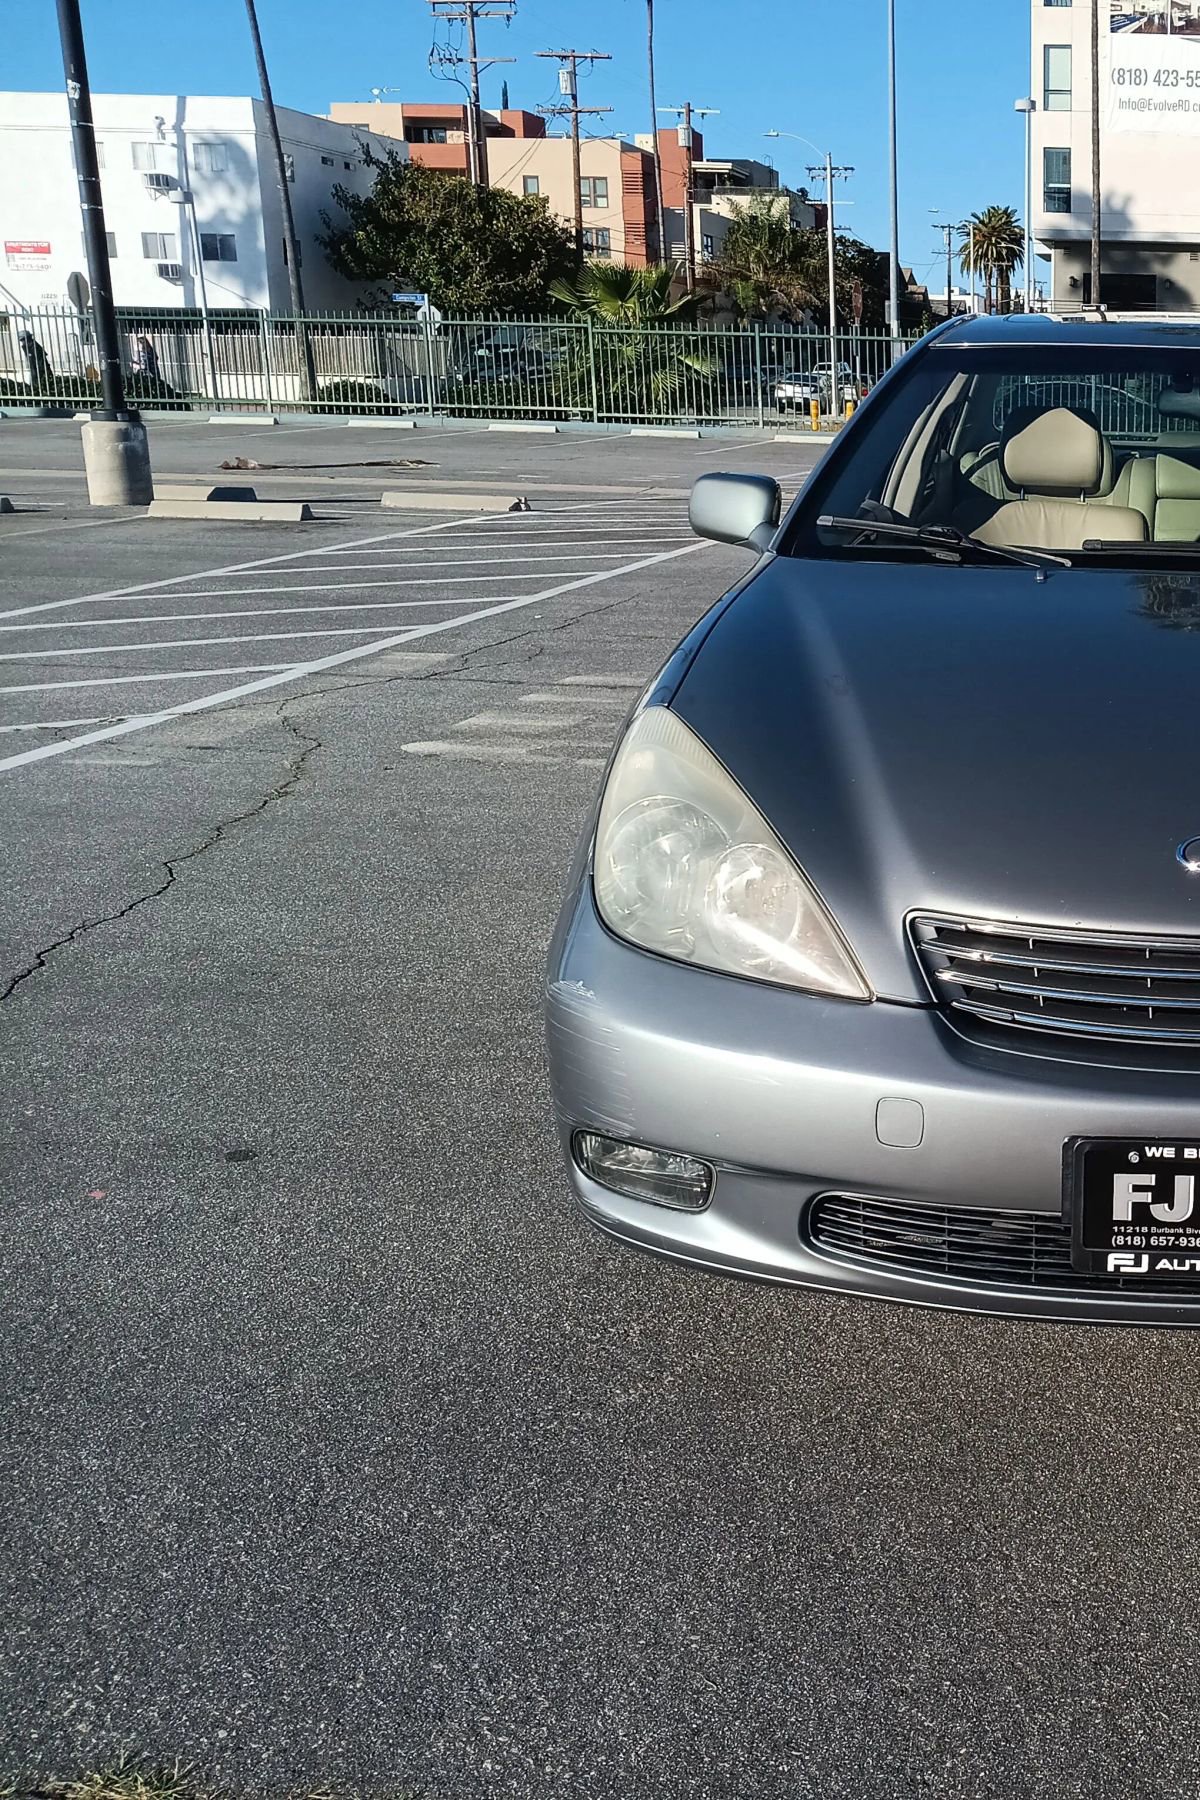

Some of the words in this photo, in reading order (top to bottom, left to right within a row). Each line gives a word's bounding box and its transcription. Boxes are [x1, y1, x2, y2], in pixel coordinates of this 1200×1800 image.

[1111, 67, 1148, 87] (818)
[1145, 1146, 1175, 1158] WE
[1112, 1173, 1195, 1222] FJ
[1150, 1226, 1184, 1234] Burbank
[1111, 1235, 1146, 1248] (818)
[1107, 1253, 1149, 1273] FJ
